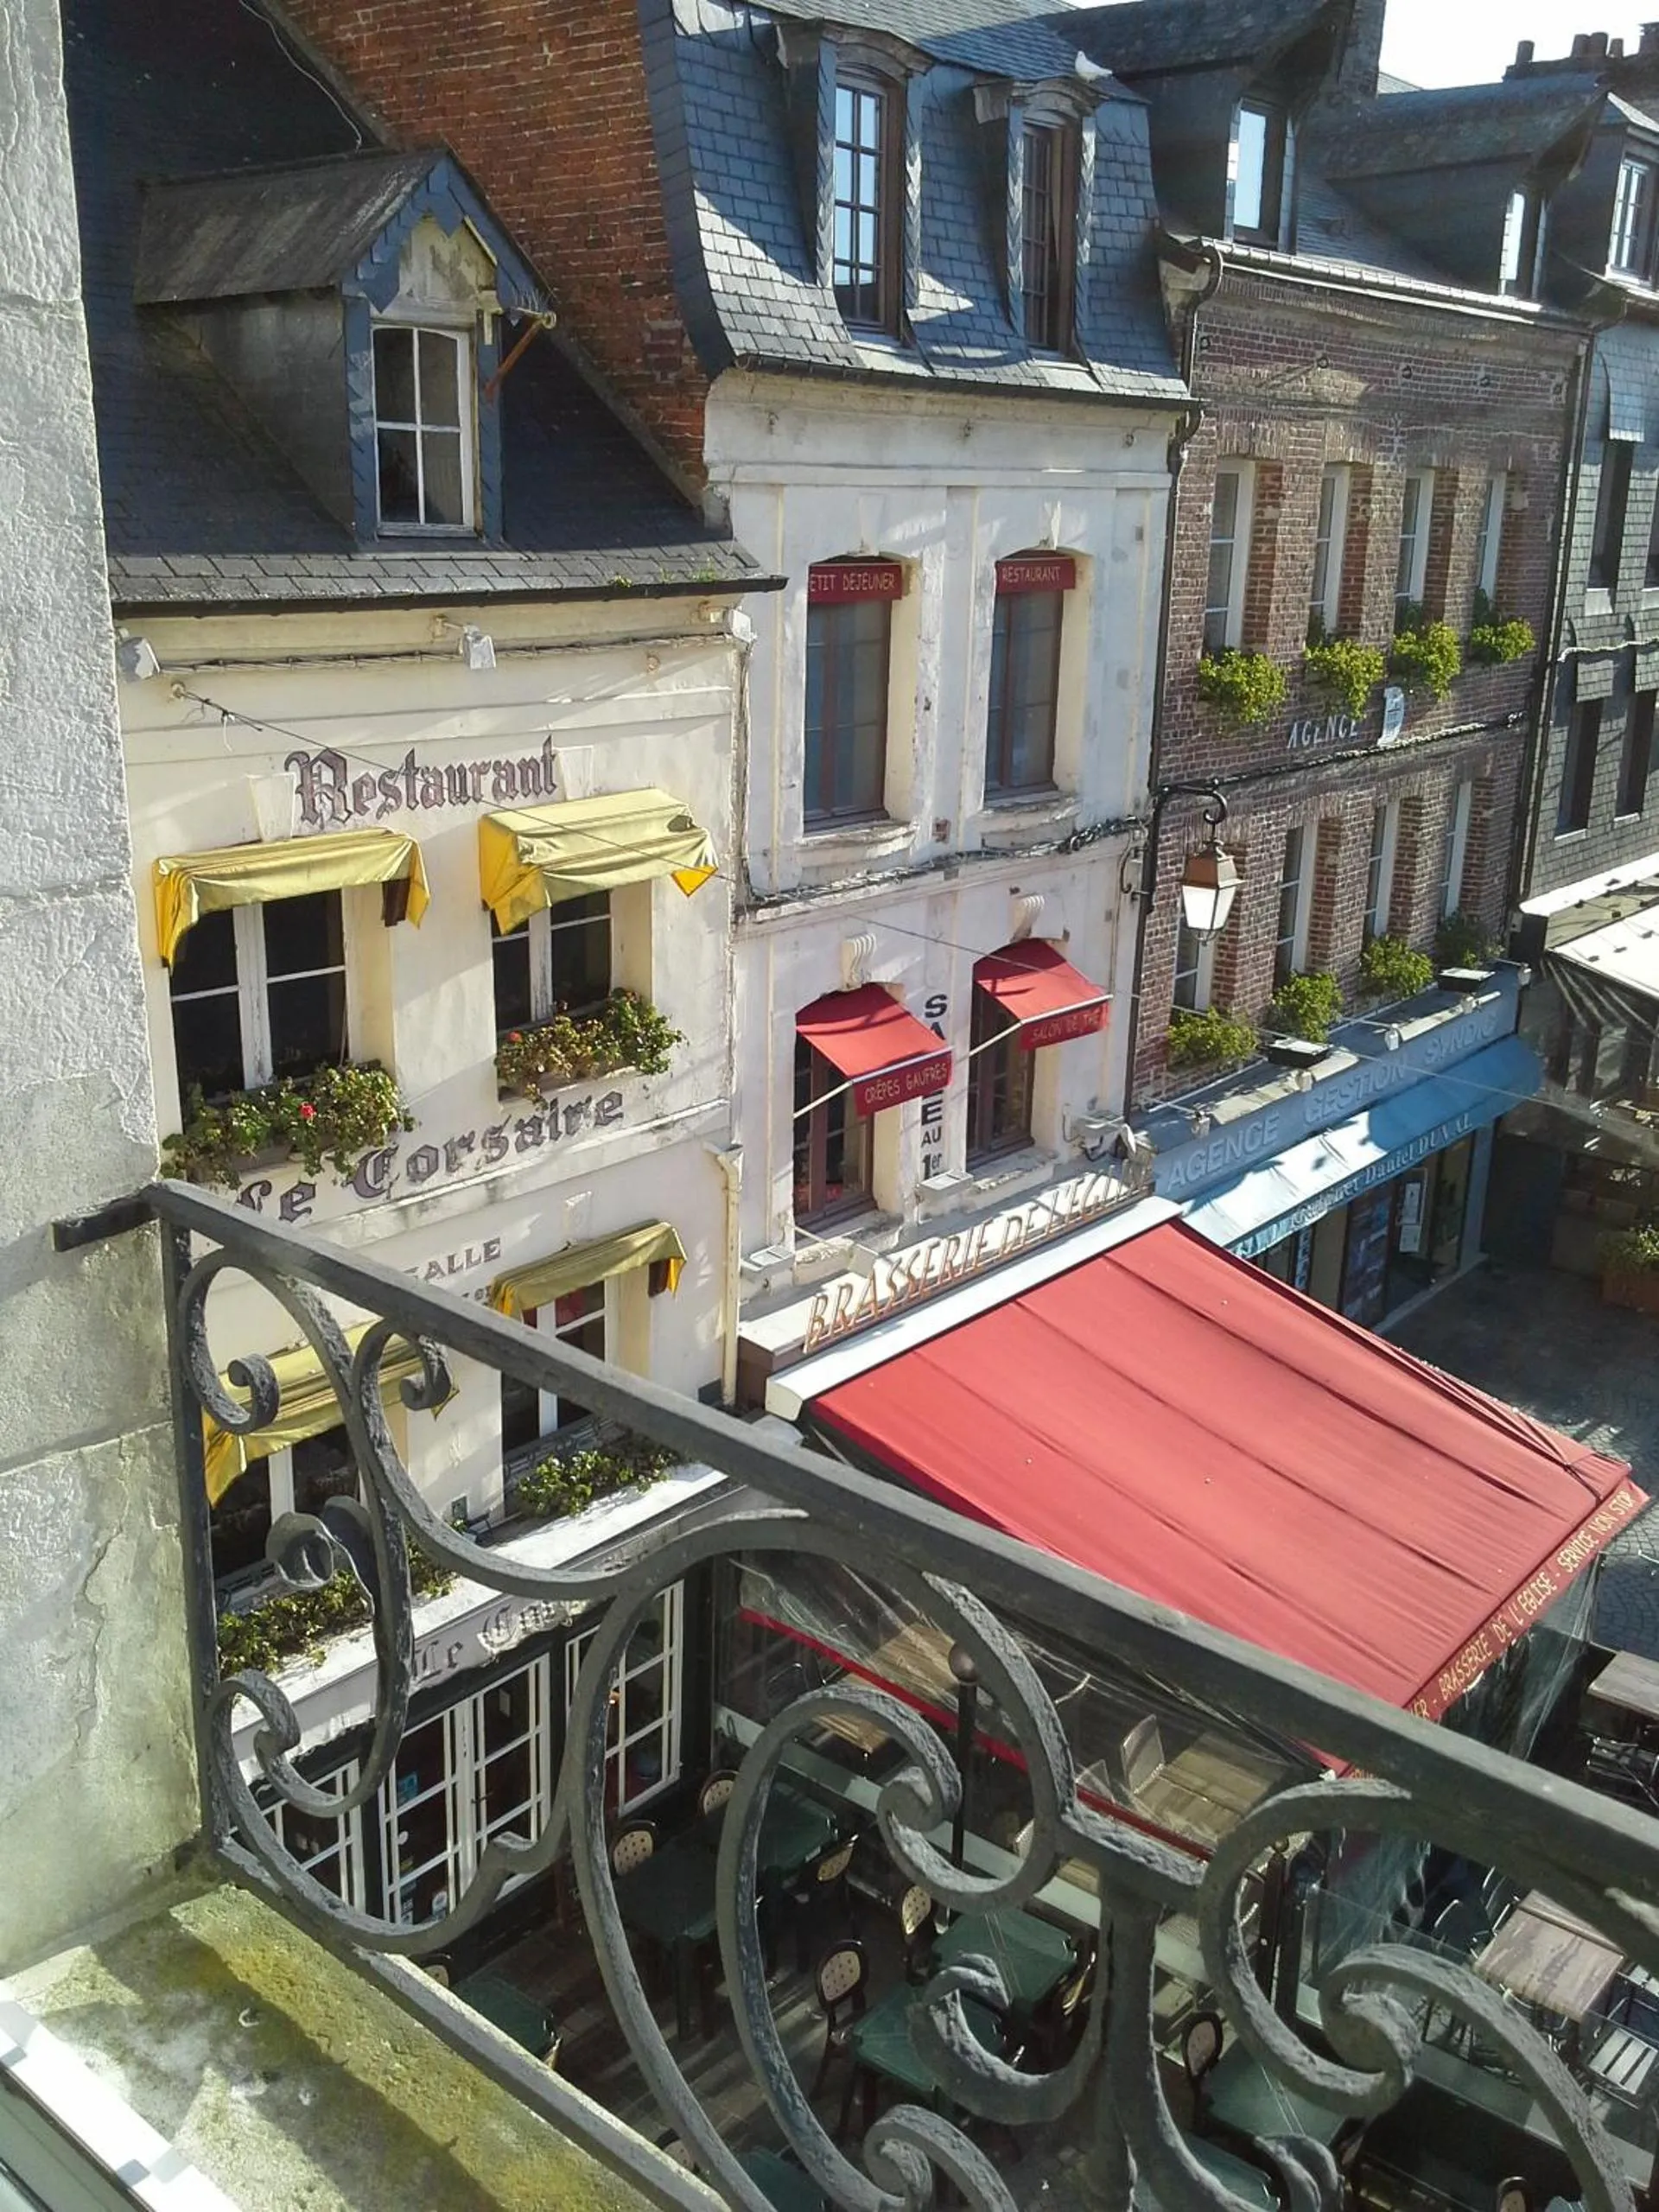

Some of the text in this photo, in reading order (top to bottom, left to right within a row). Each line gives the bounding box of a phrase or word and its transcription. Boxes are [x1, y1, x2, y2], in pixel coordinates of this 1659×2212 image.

[809, 572, 836, 593] ETIT
[1002, 565, 1062, 583] RESTAURANT
[1287, 714, 1357, 749] AGENCE
[283, 734, 557, 830] Restaurant
[906, 1063, 948, 1090] GAUFRES
[344, 1087, 625, 1201] Corsaire
[921, 1126, 943, 1147] AU
[1167, 1110, 1282, 1192] AGENCE
[1304, 1052, 1408, 1125] GESTION
[803, 1216, 993, 1354] BRASSERIE
[1001, 1202, 1039, 1255] DE
[1438, 1633, 1493, 1701] BRASSERIE
[1490, 1619, 1512, 1643] DE
[1556, 1530, 1599, 1573] SERVICE
[1588, 1511, 1619, 1536] NON
[1608, 1490, 1637, 1516] STOP
